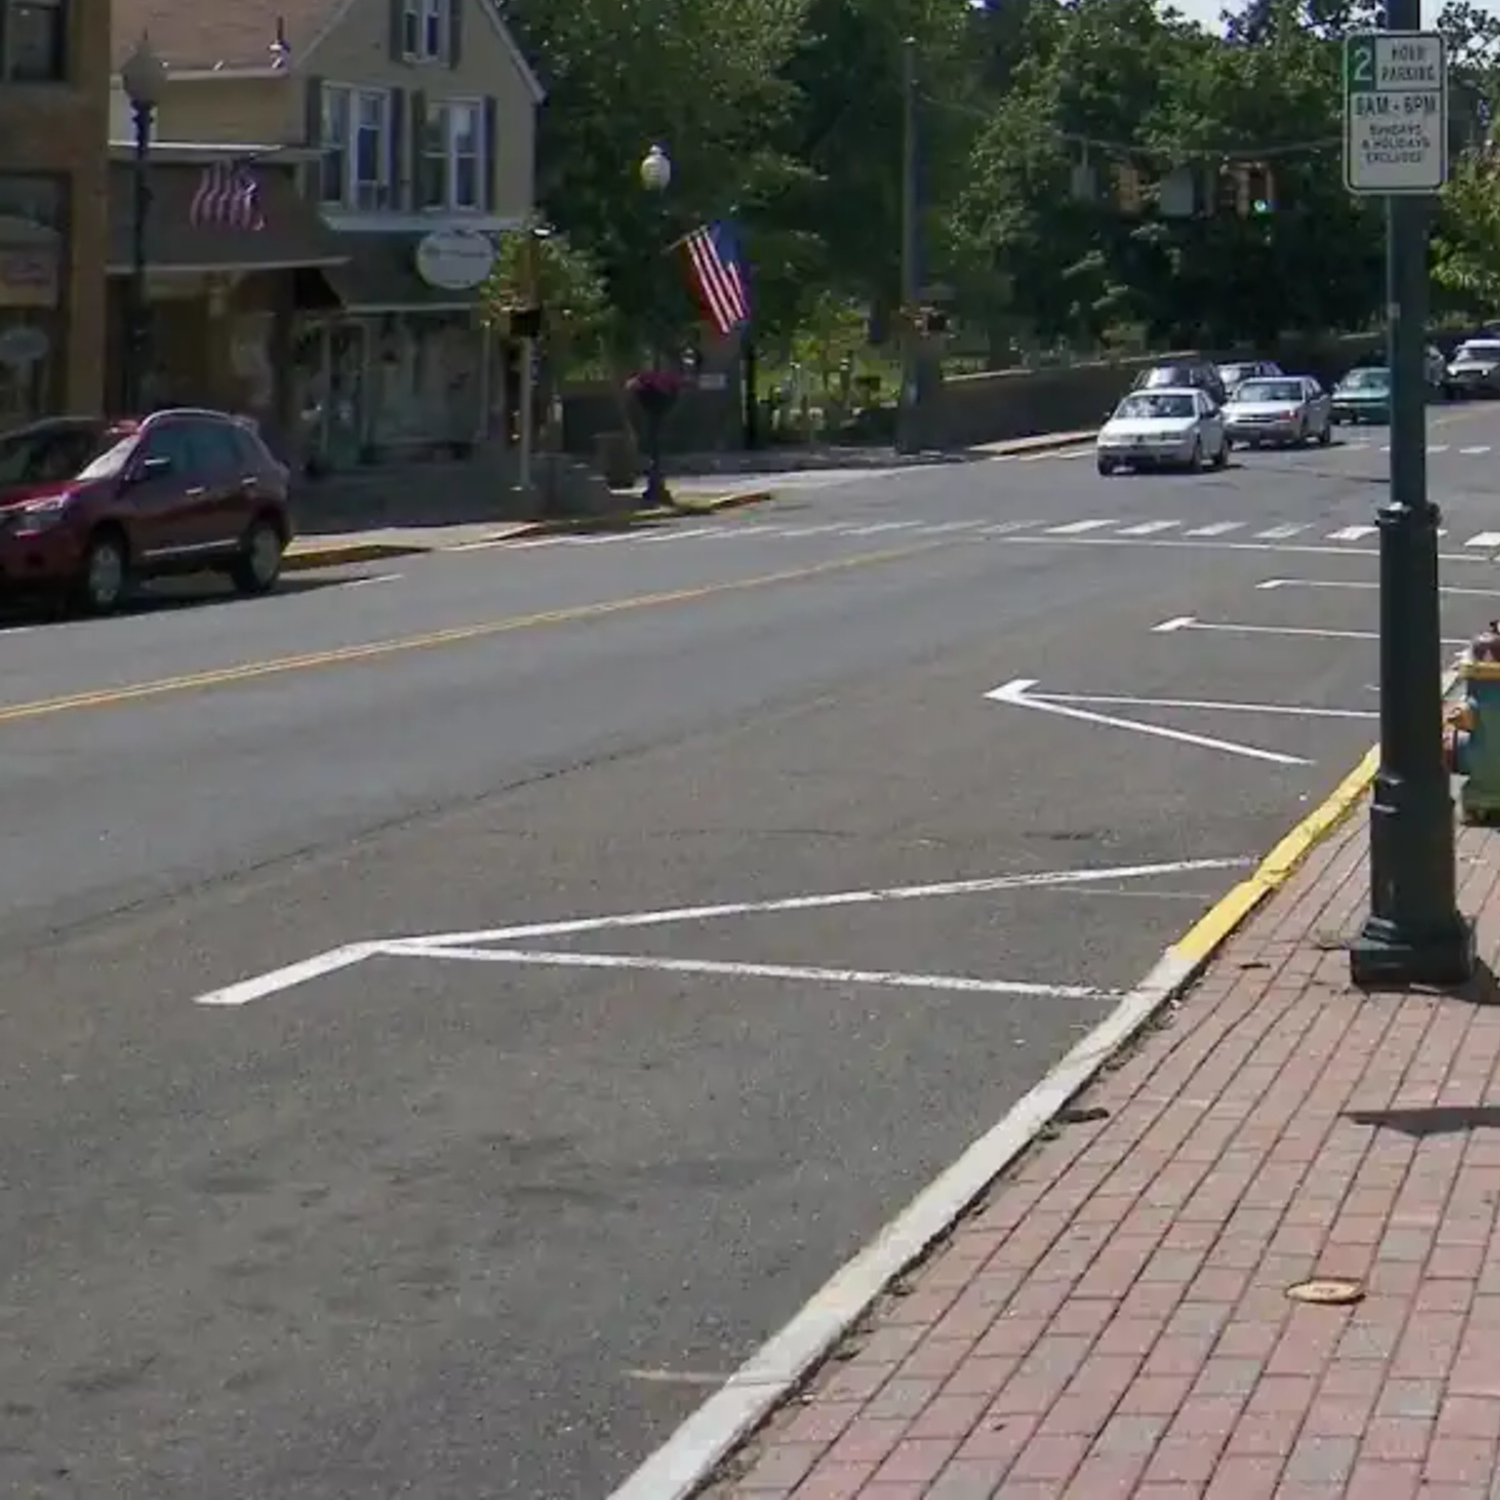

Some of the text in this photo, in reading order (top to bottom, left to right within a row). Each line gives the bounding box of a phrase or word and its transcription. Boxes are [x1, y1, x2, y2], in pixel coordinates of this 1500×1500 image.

[1391, 44, 1426, 61] HOUR
[1354, 47, 1373, 81] 2
[1381, 65, 1435, 81] PARKING
[1369, 124, 1421, 136] SUNDAYS
[1373, 137, 1431, 149] HOLIDAYS
